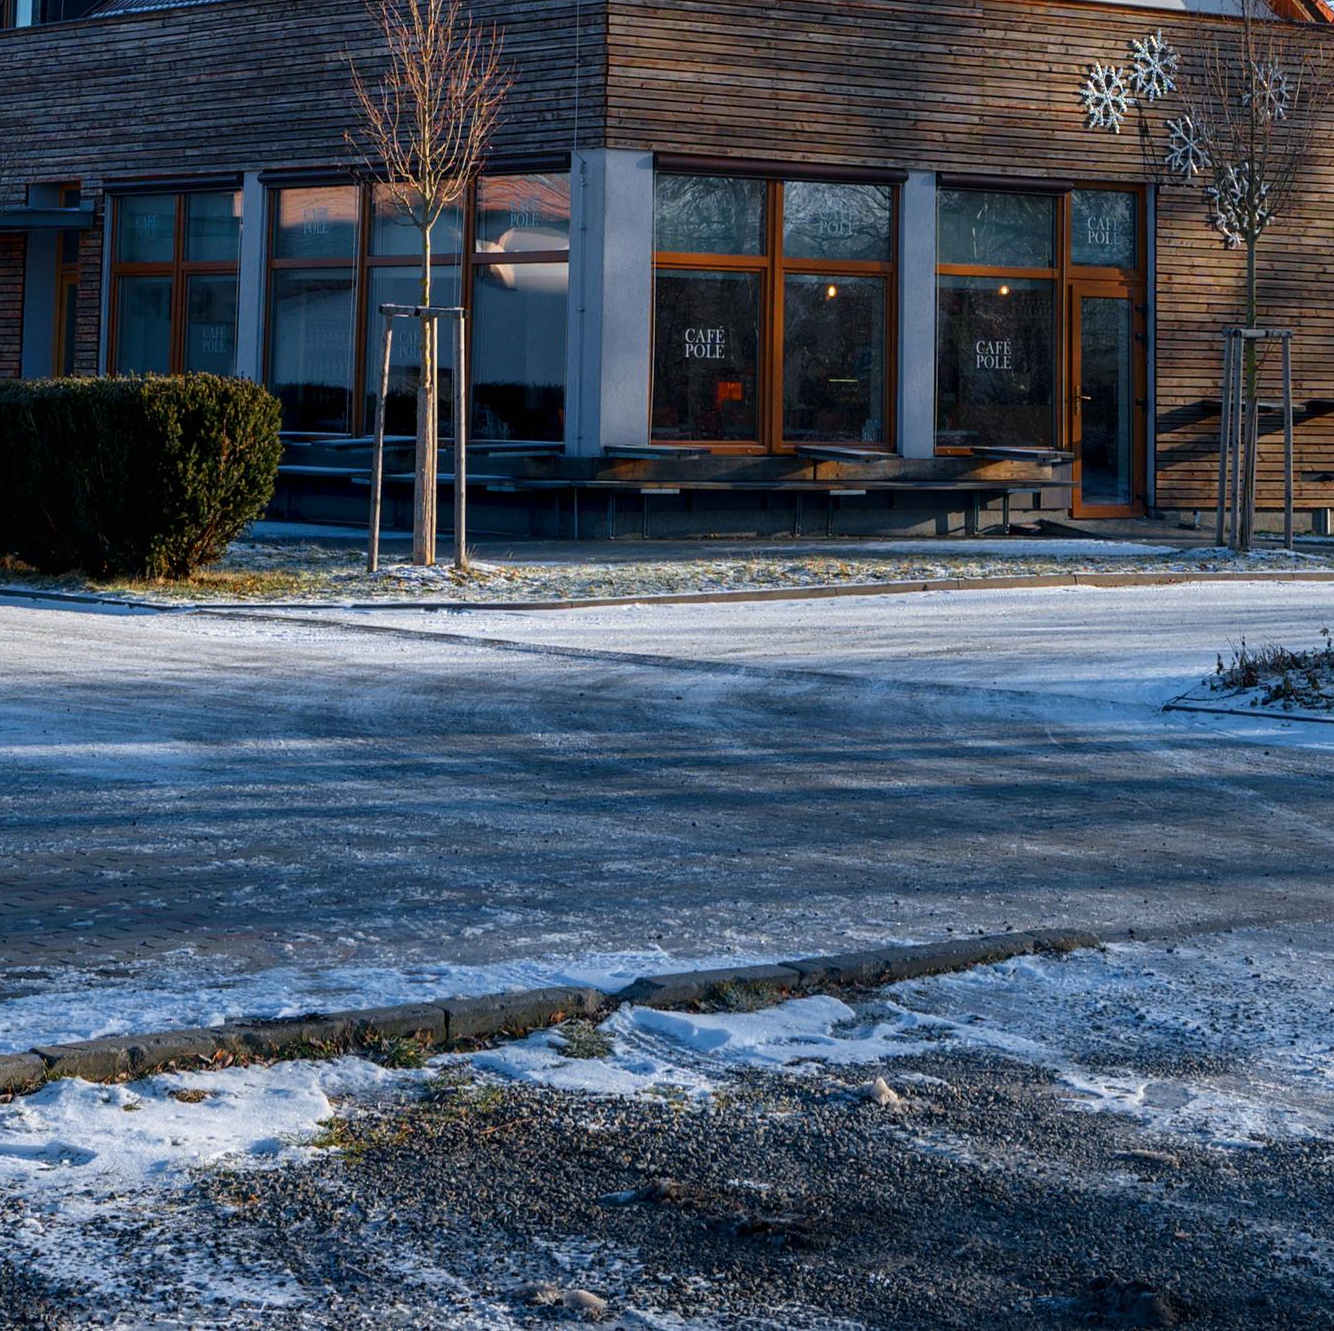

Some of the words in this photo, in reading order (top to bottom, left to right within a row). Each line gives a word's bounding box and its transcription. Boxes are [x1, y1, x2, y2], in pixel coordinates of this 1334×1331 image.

[685, 326, 725, 344] CAFÉ
[685, 344, 725, 359] POLE
[976, 338, 1012, 355] CAFÉ
[976, 355, 1012, 369] POLE
